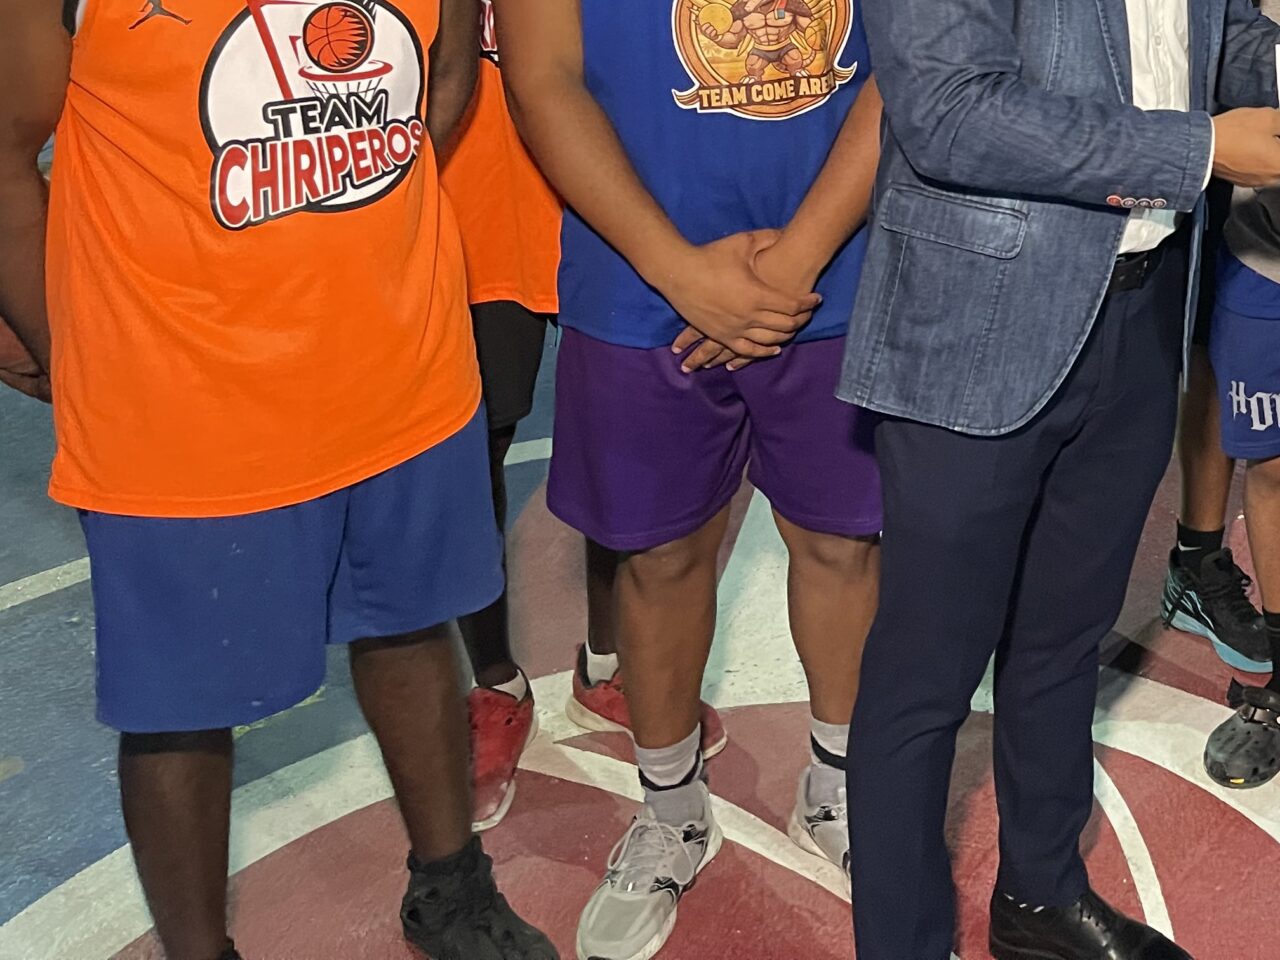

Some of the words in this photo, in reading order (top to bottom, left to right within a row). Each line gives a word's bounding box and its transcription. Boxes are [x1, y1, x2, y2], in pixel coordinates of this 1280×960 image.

[270, 92, 387, 139] TEAM
[699, 86, 747, 107] TEAM
[751, 80, 795, 102] COME
[217, 120, 424, 228] CHIRIPEROS
